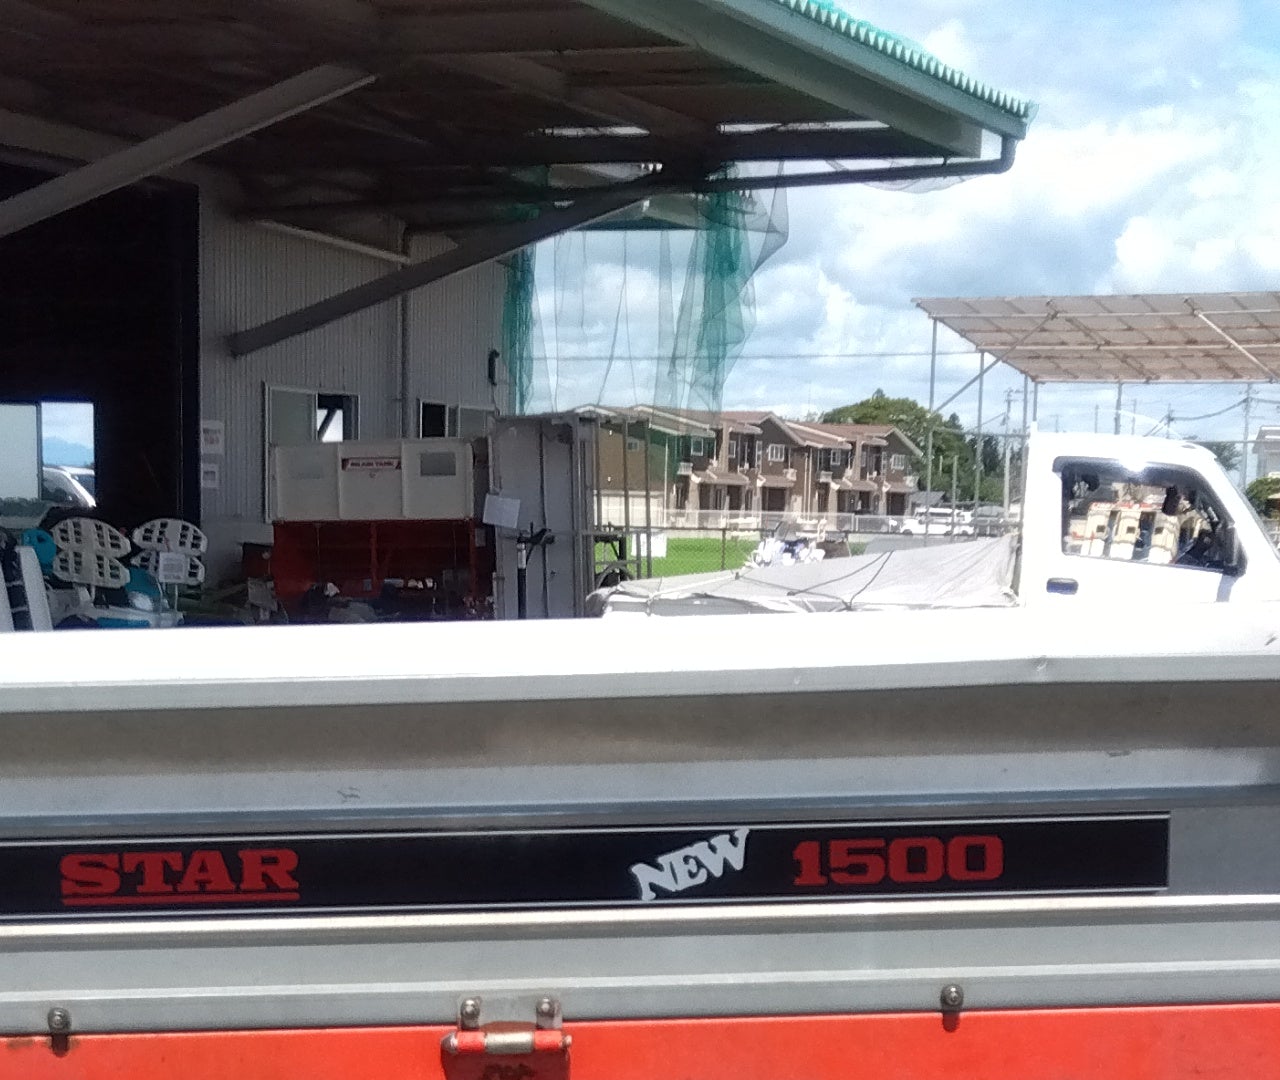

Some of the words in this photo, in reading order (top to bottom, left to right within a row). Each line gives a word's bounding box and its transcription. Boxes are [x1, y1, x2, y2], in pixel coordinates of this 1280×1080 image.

[60, 849, 300, 896] STAR
[631, 829, 749, 900] NEW
[792, 835, 1004, 886] 1500
